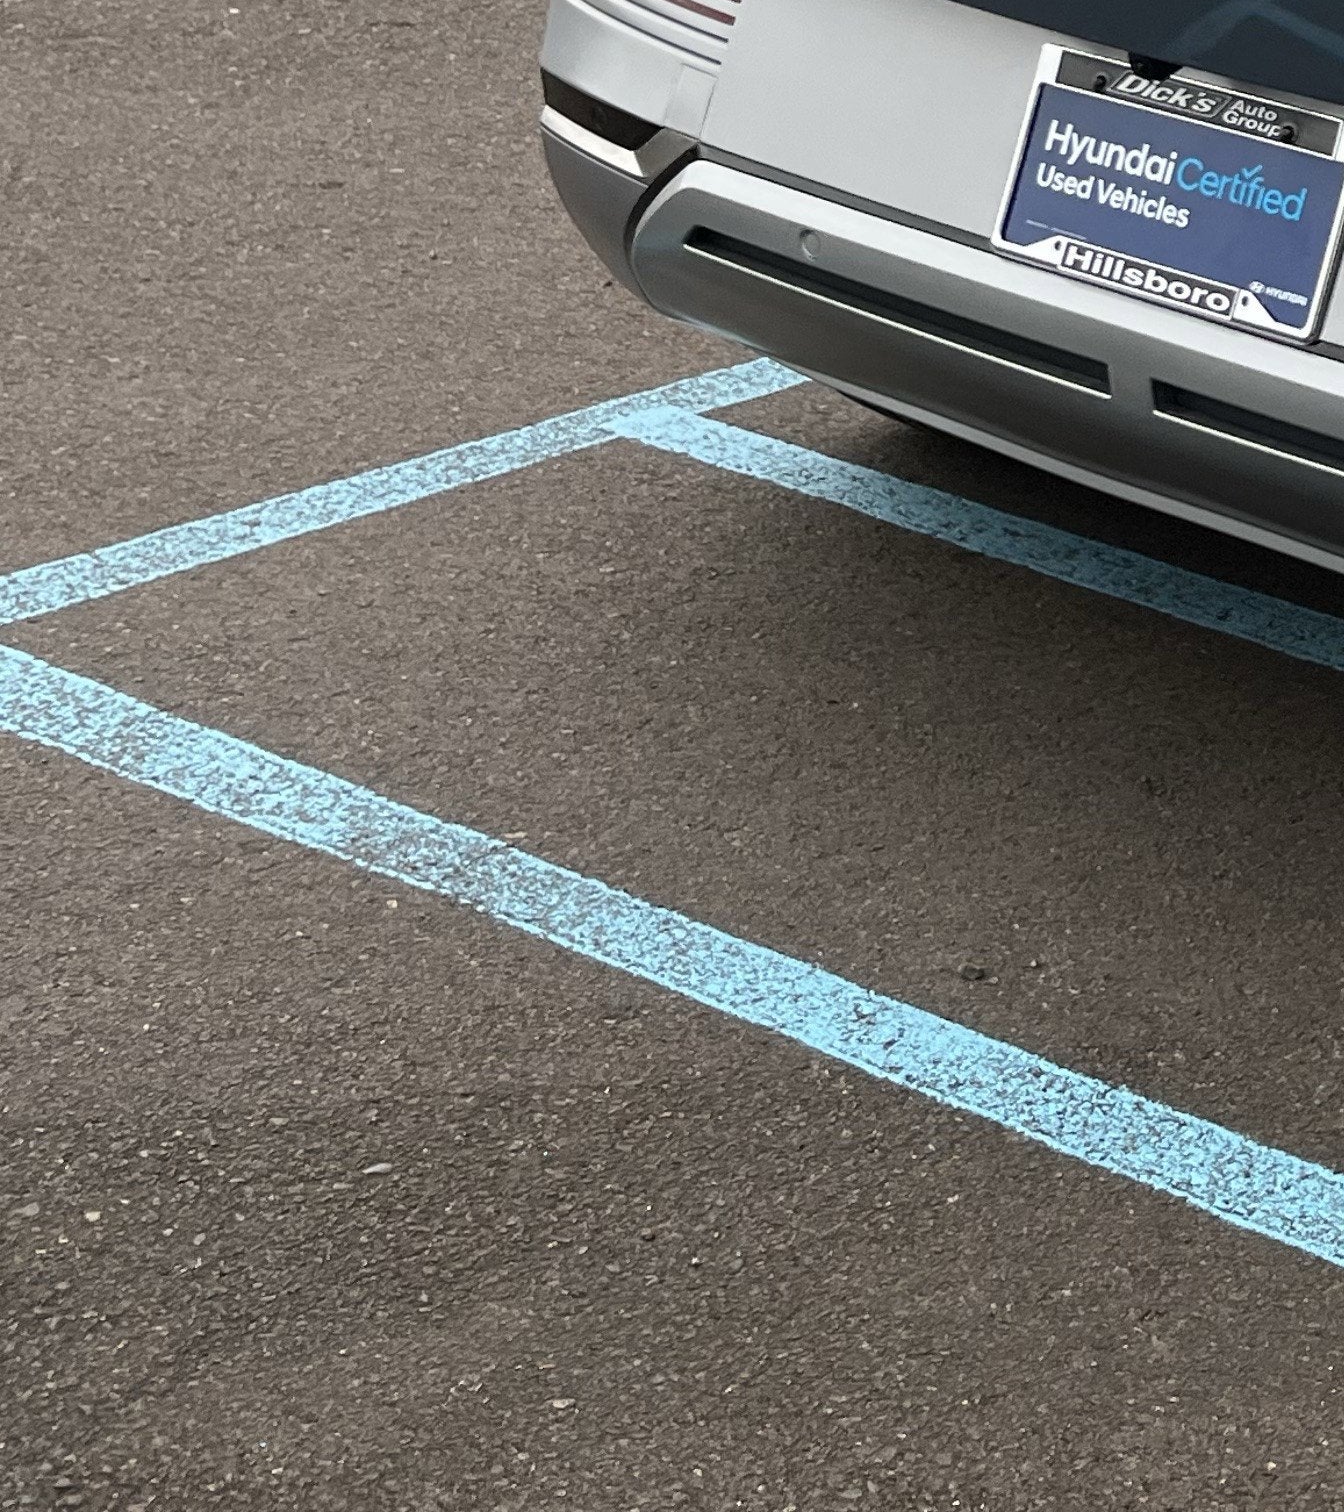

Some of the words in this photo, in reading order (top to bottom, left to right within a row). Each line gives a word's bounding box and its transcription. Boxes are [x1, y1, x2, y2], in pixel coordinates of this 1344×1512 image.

[1117, 74, 1217, 113] Dick's
[1229, 99, 1278, 122] Auto
[1222, 113, 1284, 139] Group
[1036, 163, 1096, 200] Used
[1097, 178, 1190, 229] Vehicles
[1044, 119, 1178, 185] Hyundai
[1176, 157, 1308, 222] Certified
[1063, 245, 1231, 313] Hillsboro
